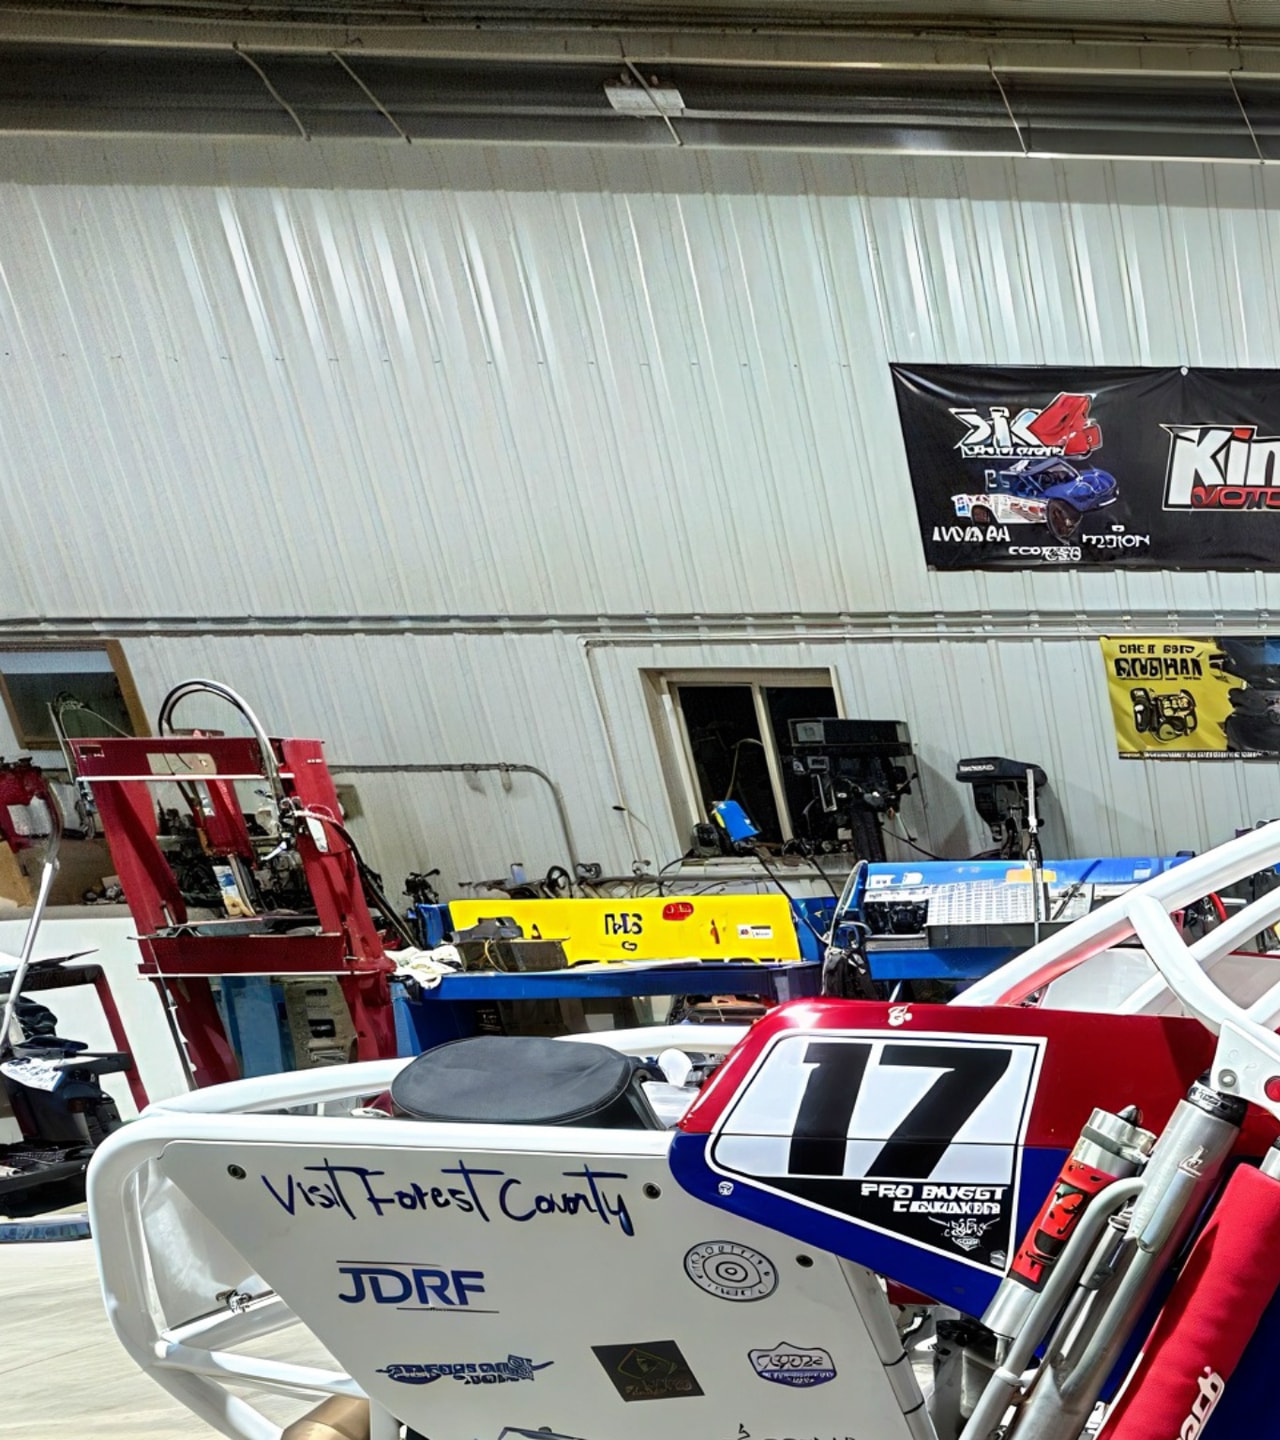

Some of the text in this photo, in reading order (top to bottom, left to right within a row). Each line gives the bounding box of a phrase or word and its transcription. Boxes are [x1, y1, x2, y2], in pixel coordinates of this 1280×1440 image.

[787, 1042, 1012, 1179] 17
[261, 1158, 367, 1220] Visit
[362, 1160, 503, 1222] Forest
[338, 1267, 486, 1305] JDRF
